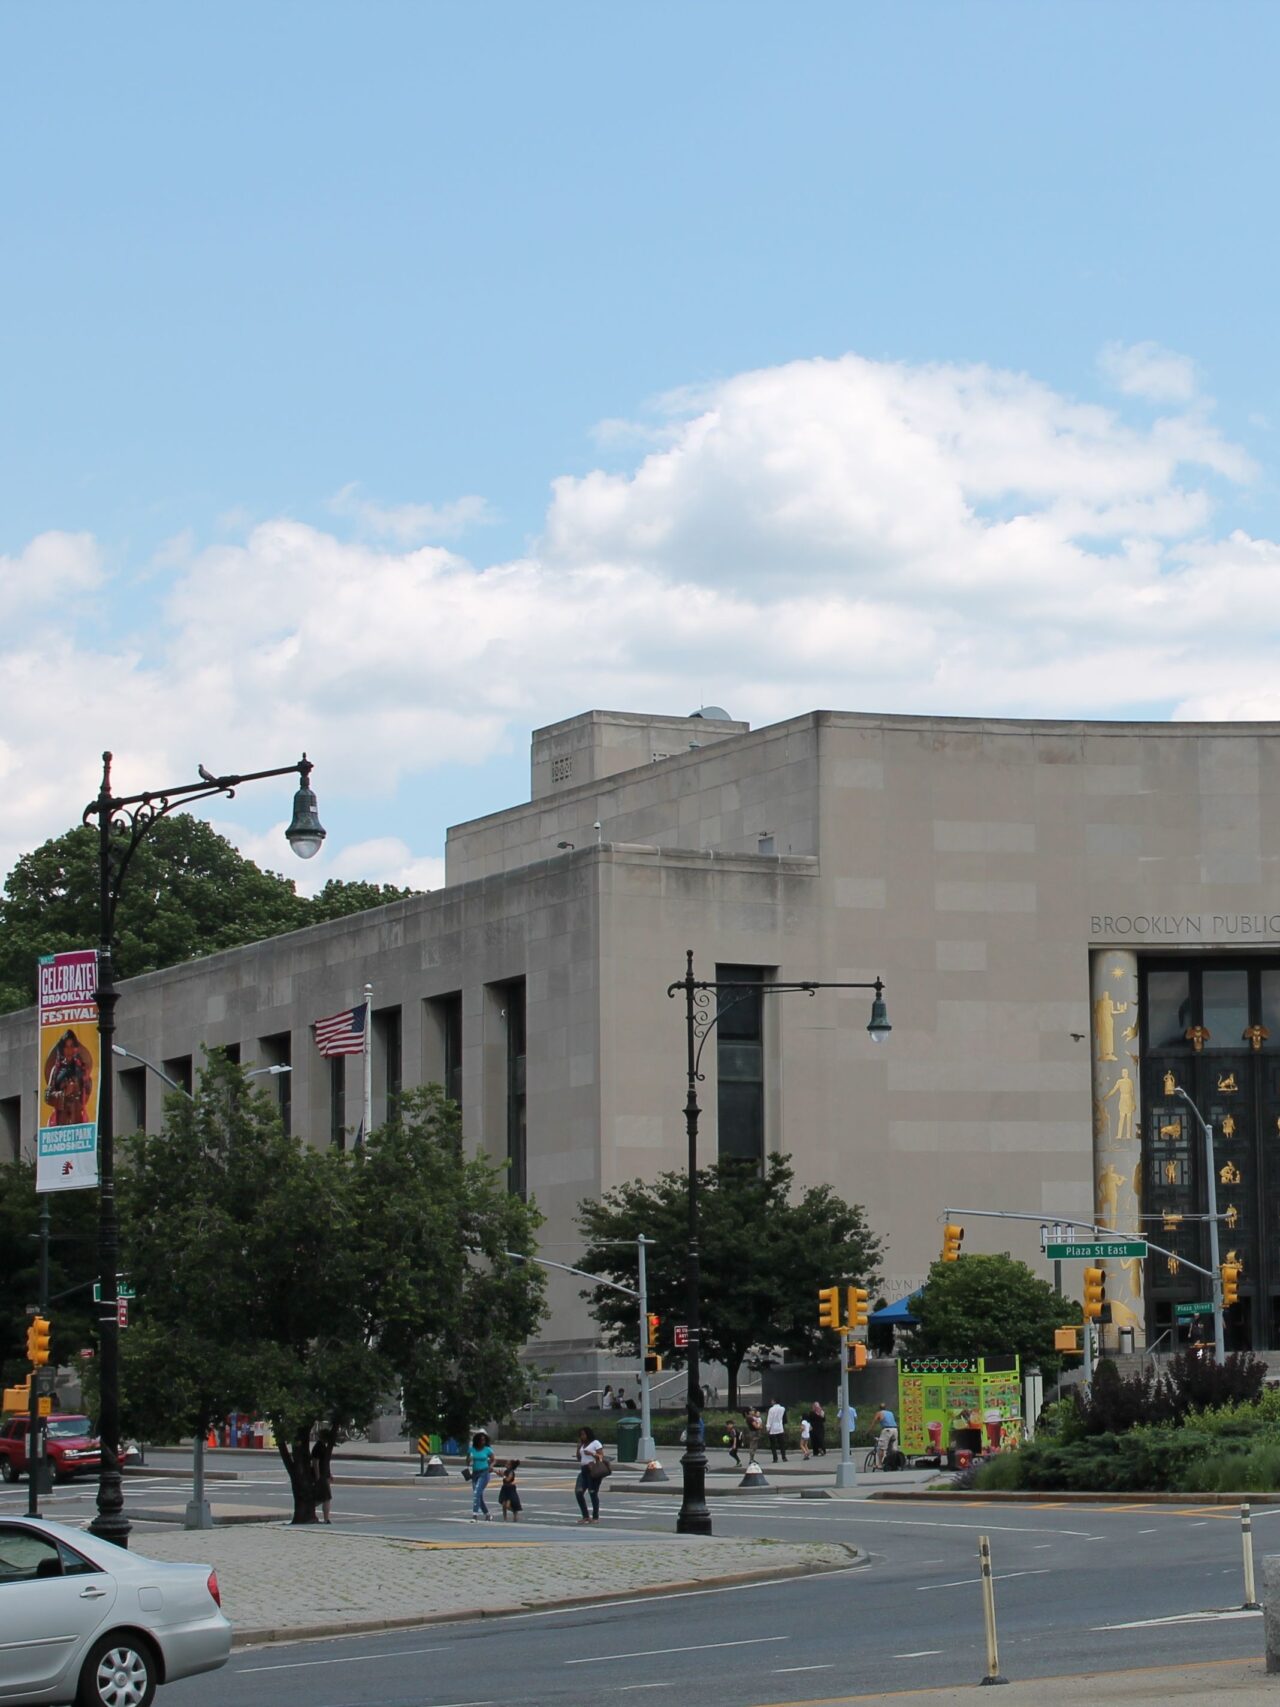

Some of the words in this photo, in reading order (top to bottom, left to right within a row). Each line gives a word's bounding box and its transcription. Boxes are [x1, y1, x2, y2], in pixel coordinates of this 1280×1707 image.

[1091, 916, 1200, 934] BROOKLYN
[42, 1008, 97, 1024] FESTIVAL
[42, 1129, 75, 1144] PROSPECT
[76, 1127, 92, 1140] PARK
[42, 1140, 92, 1153] BANDSHELL
[1066, 1247, 1091, 1256] Plaza
[1095, 1246, 1104, 1255] St
[1108, 1245, 1127, 1255] East
